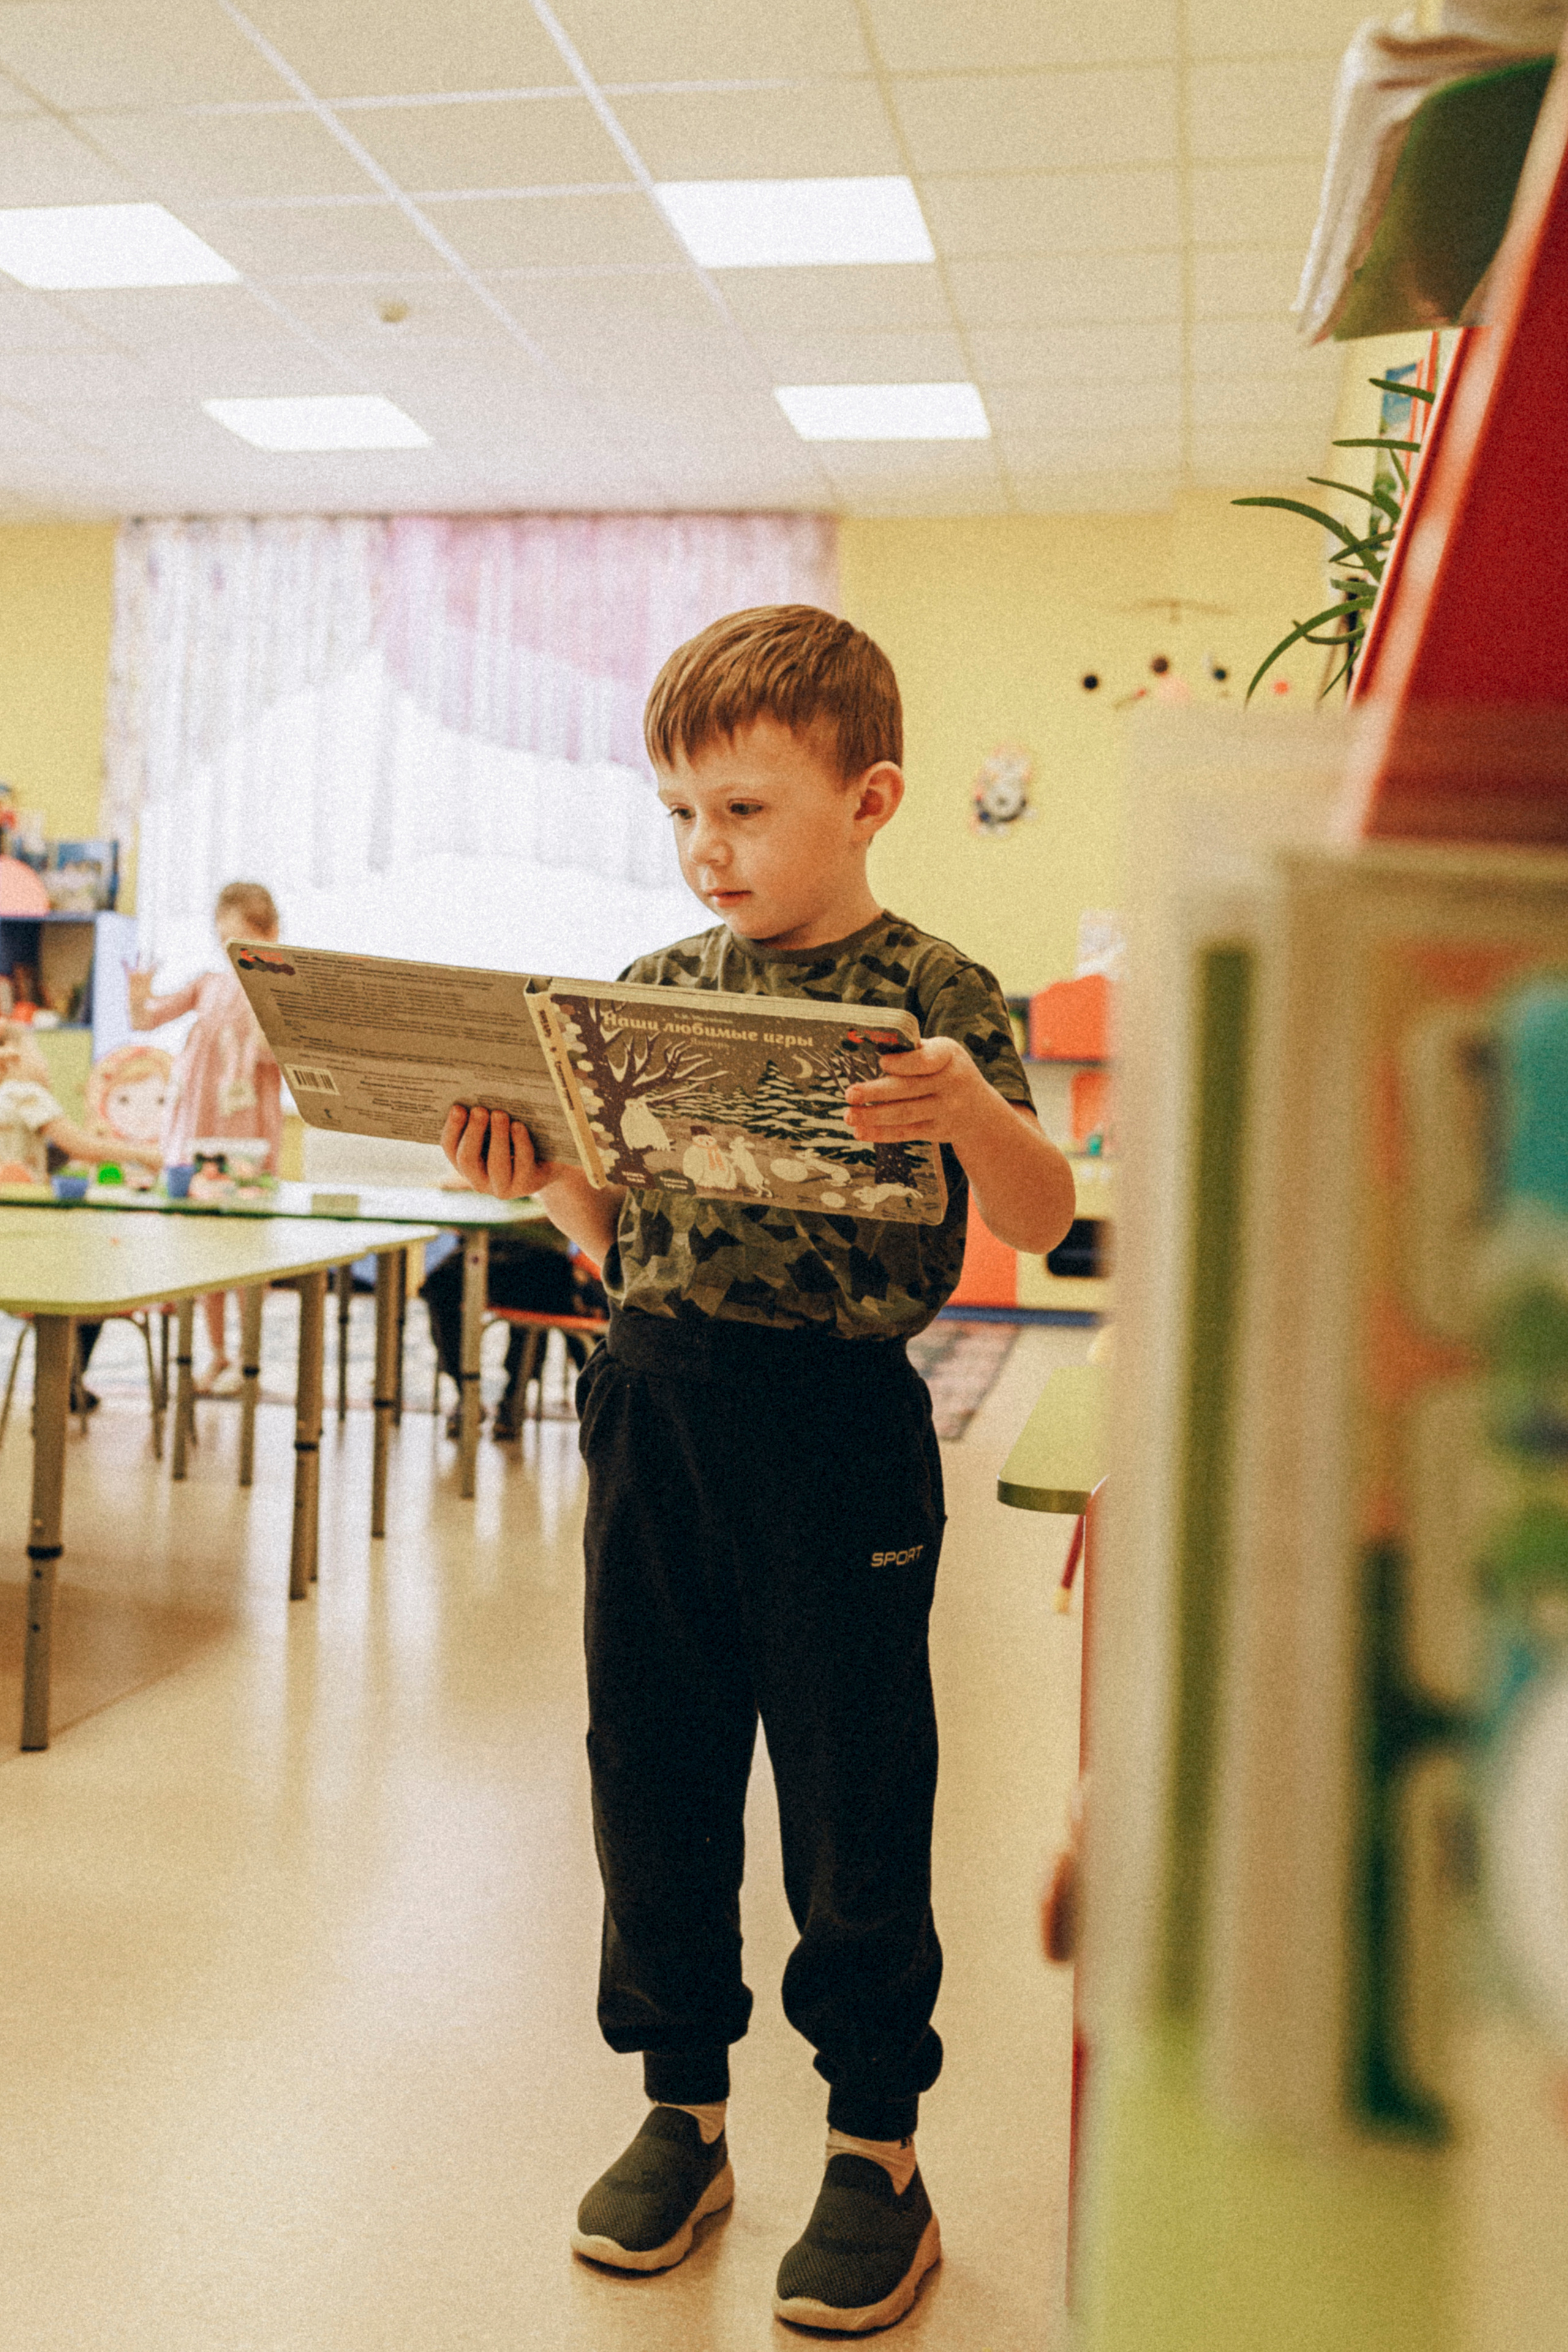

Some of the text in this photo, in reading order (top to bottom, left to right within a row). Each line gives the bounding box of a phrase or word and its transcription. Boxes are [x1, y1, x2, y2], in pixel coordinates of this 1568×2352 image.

[603, 1012, 659, 1031] Наши
[663, 1022, 758, 1042] любимые
[763, 1032, 813, 1048] игры
[870, 1545, 924, 1567] SPORT
